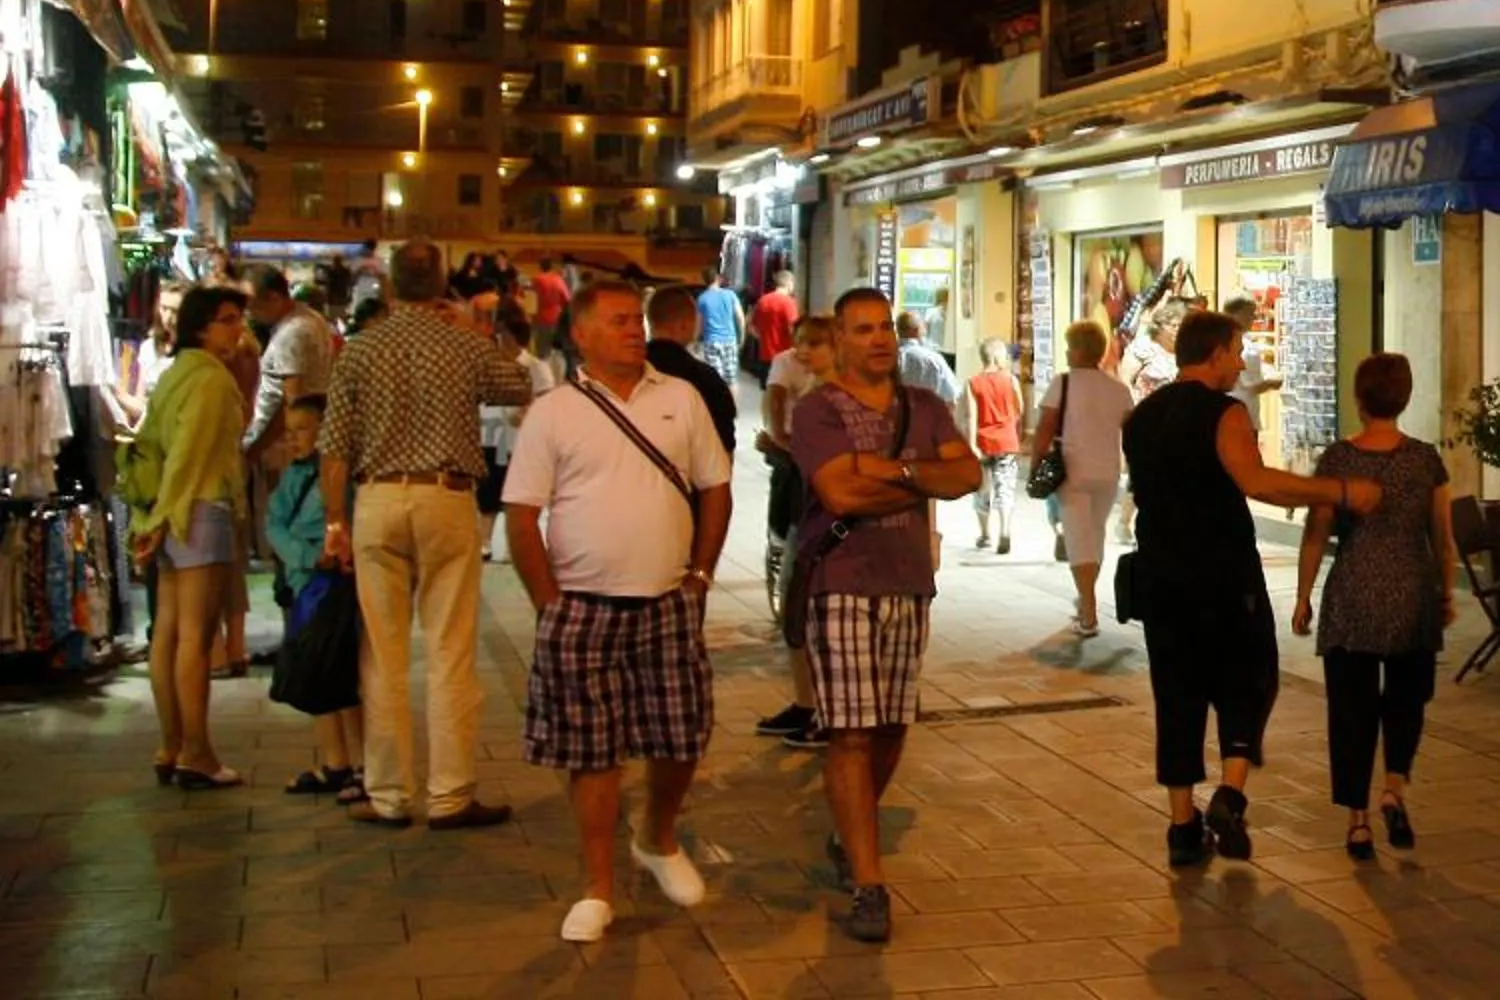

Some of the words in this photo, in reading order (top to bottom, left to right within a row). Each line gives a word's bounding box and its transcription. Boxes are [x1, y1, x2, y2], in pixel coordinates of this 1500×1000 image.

[1184, 154, 1261, 186] PERFUMERIA
[1275, 142, 1331, 170] REGALS
[1365, 135, 1428, 184] IRIS
